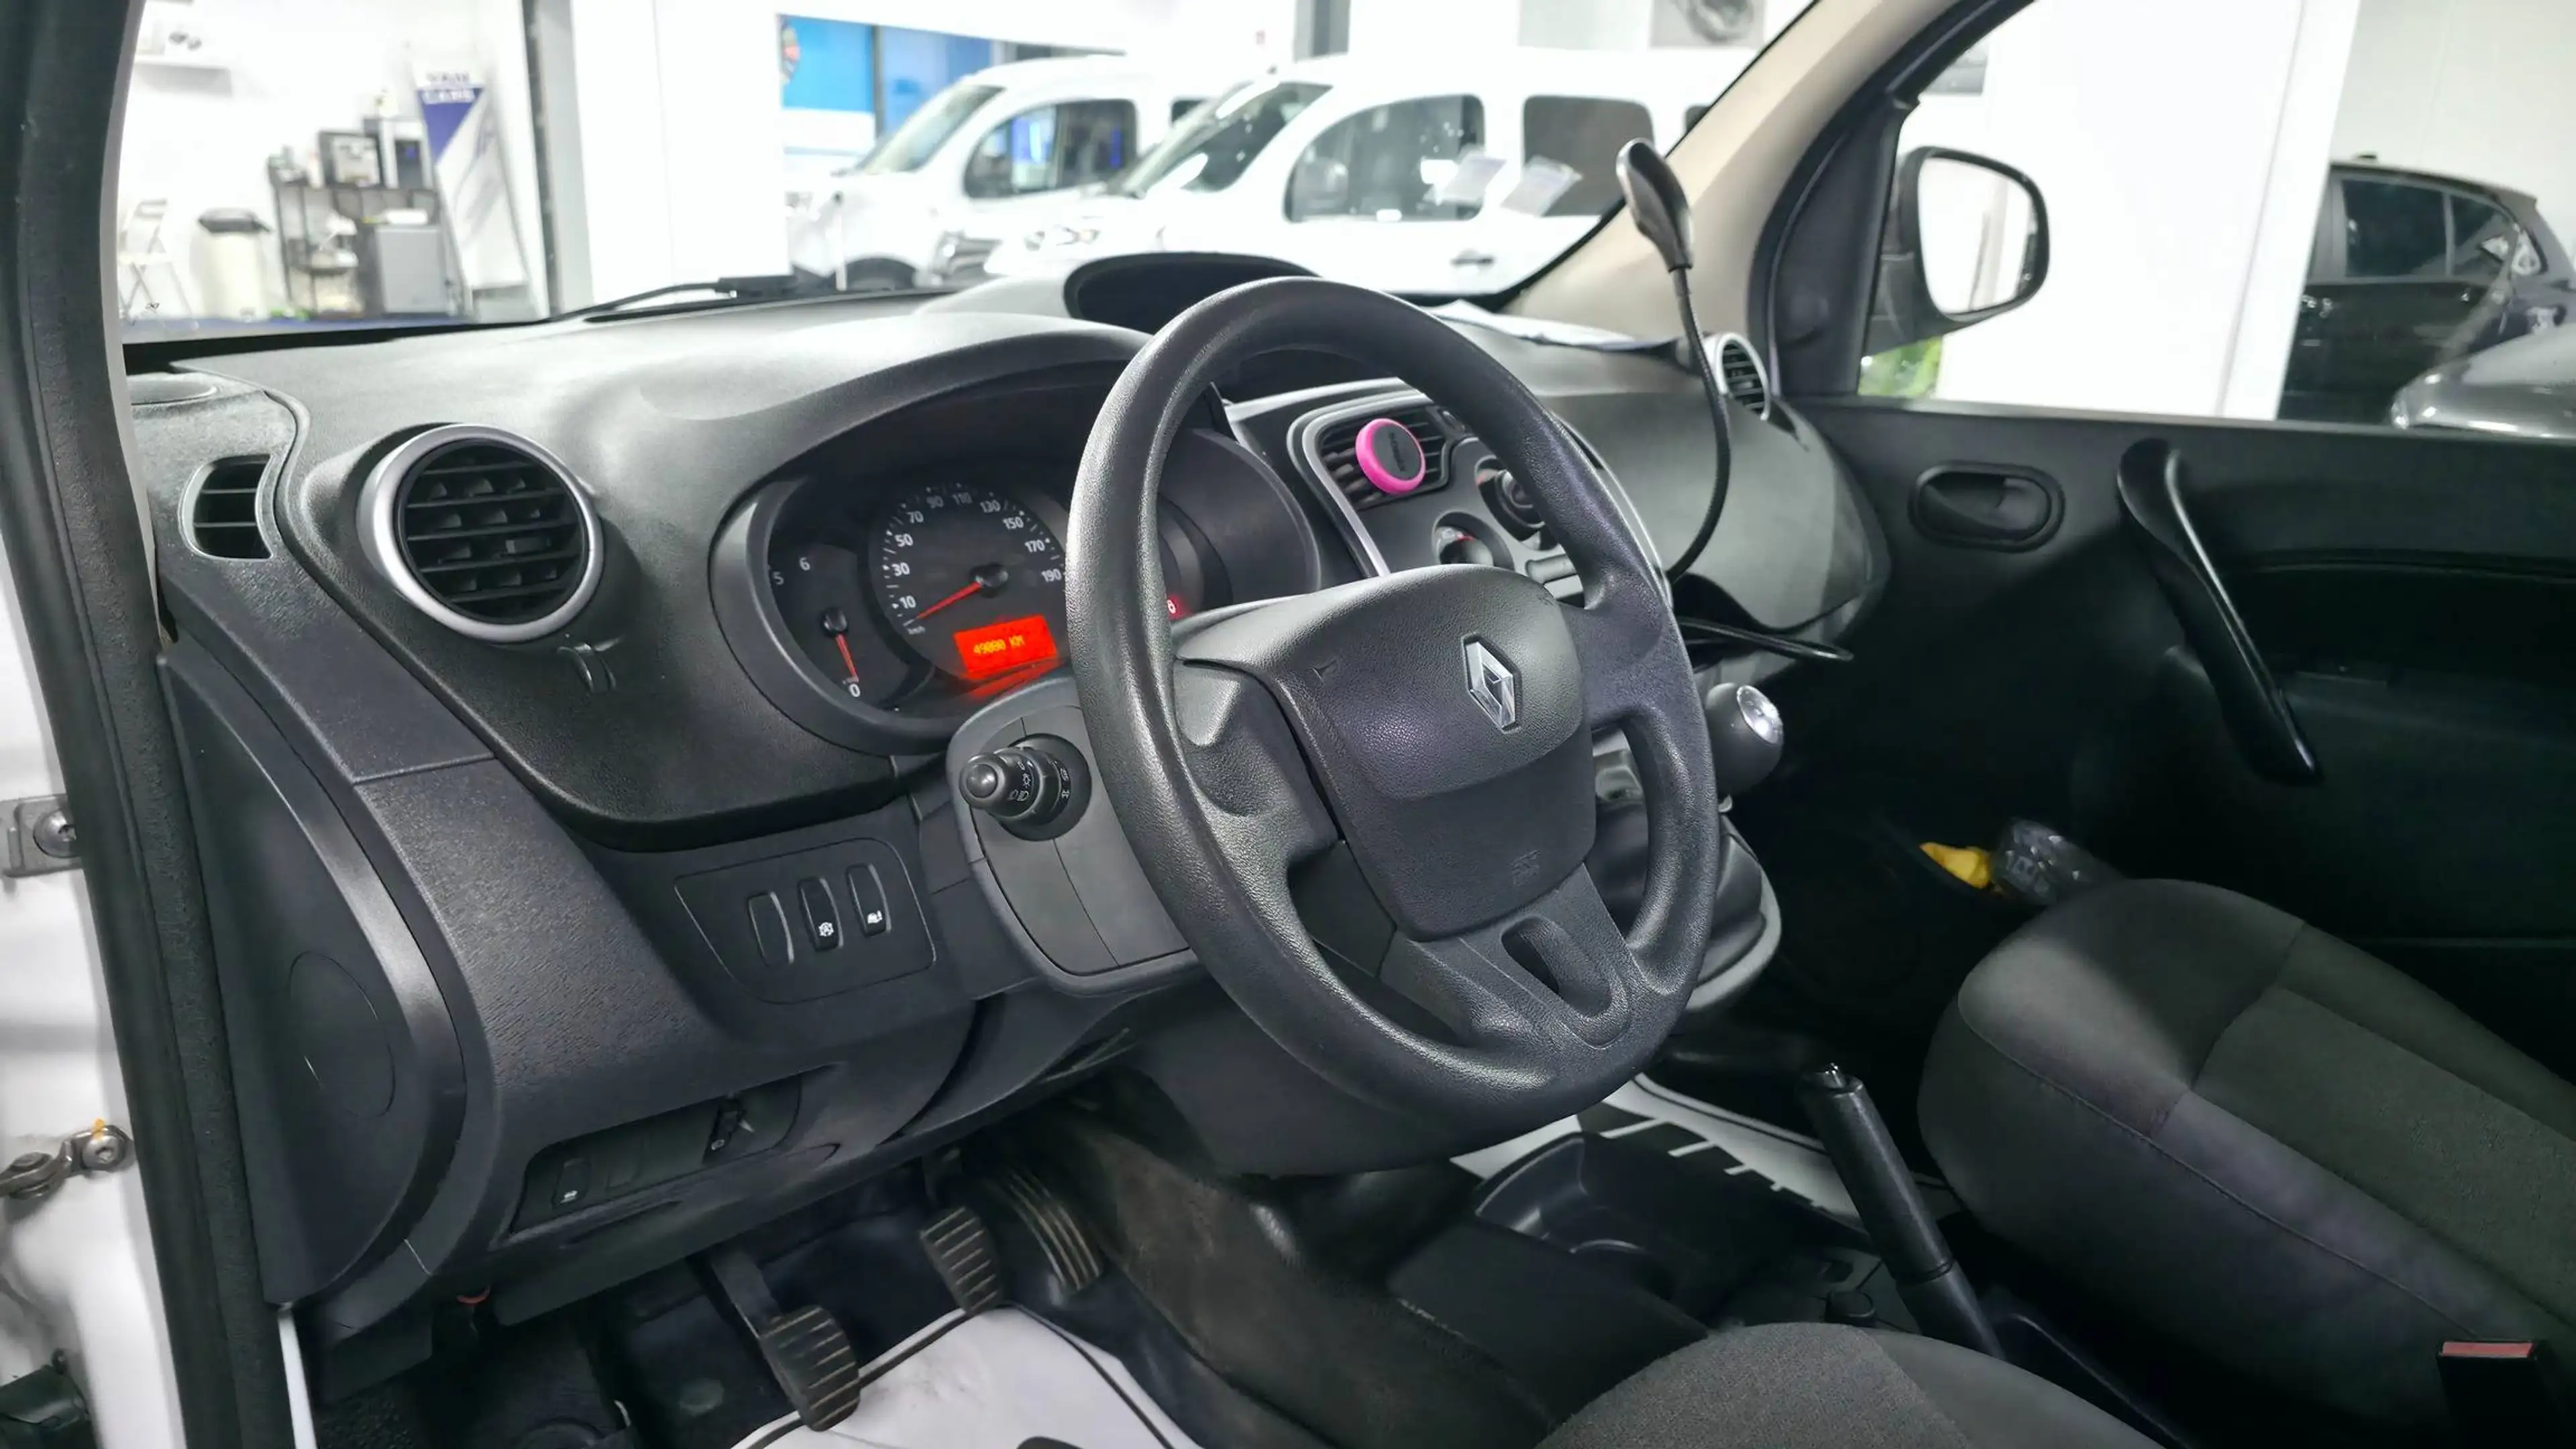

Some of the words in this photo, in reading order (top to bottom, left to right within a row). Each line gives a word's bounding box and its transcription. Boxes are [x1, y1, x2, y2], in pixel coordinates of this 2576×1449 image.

[980, 500, 1001, 513] 130
[908, 511, 924, 523] 70
[1002, 516, 1024, 530] 150
[894, 533, 914, 547] 50
[1024, 539, 1045, 553] 170
[800, 557, 810, 571] 6
[891, 562, 910, 576] 30
[773, 572, 784, 586] 5
[1041, 568, 1063, 582] 190
[900, 595, 916, 608] 10
[849, 683, 861, 698] 0
